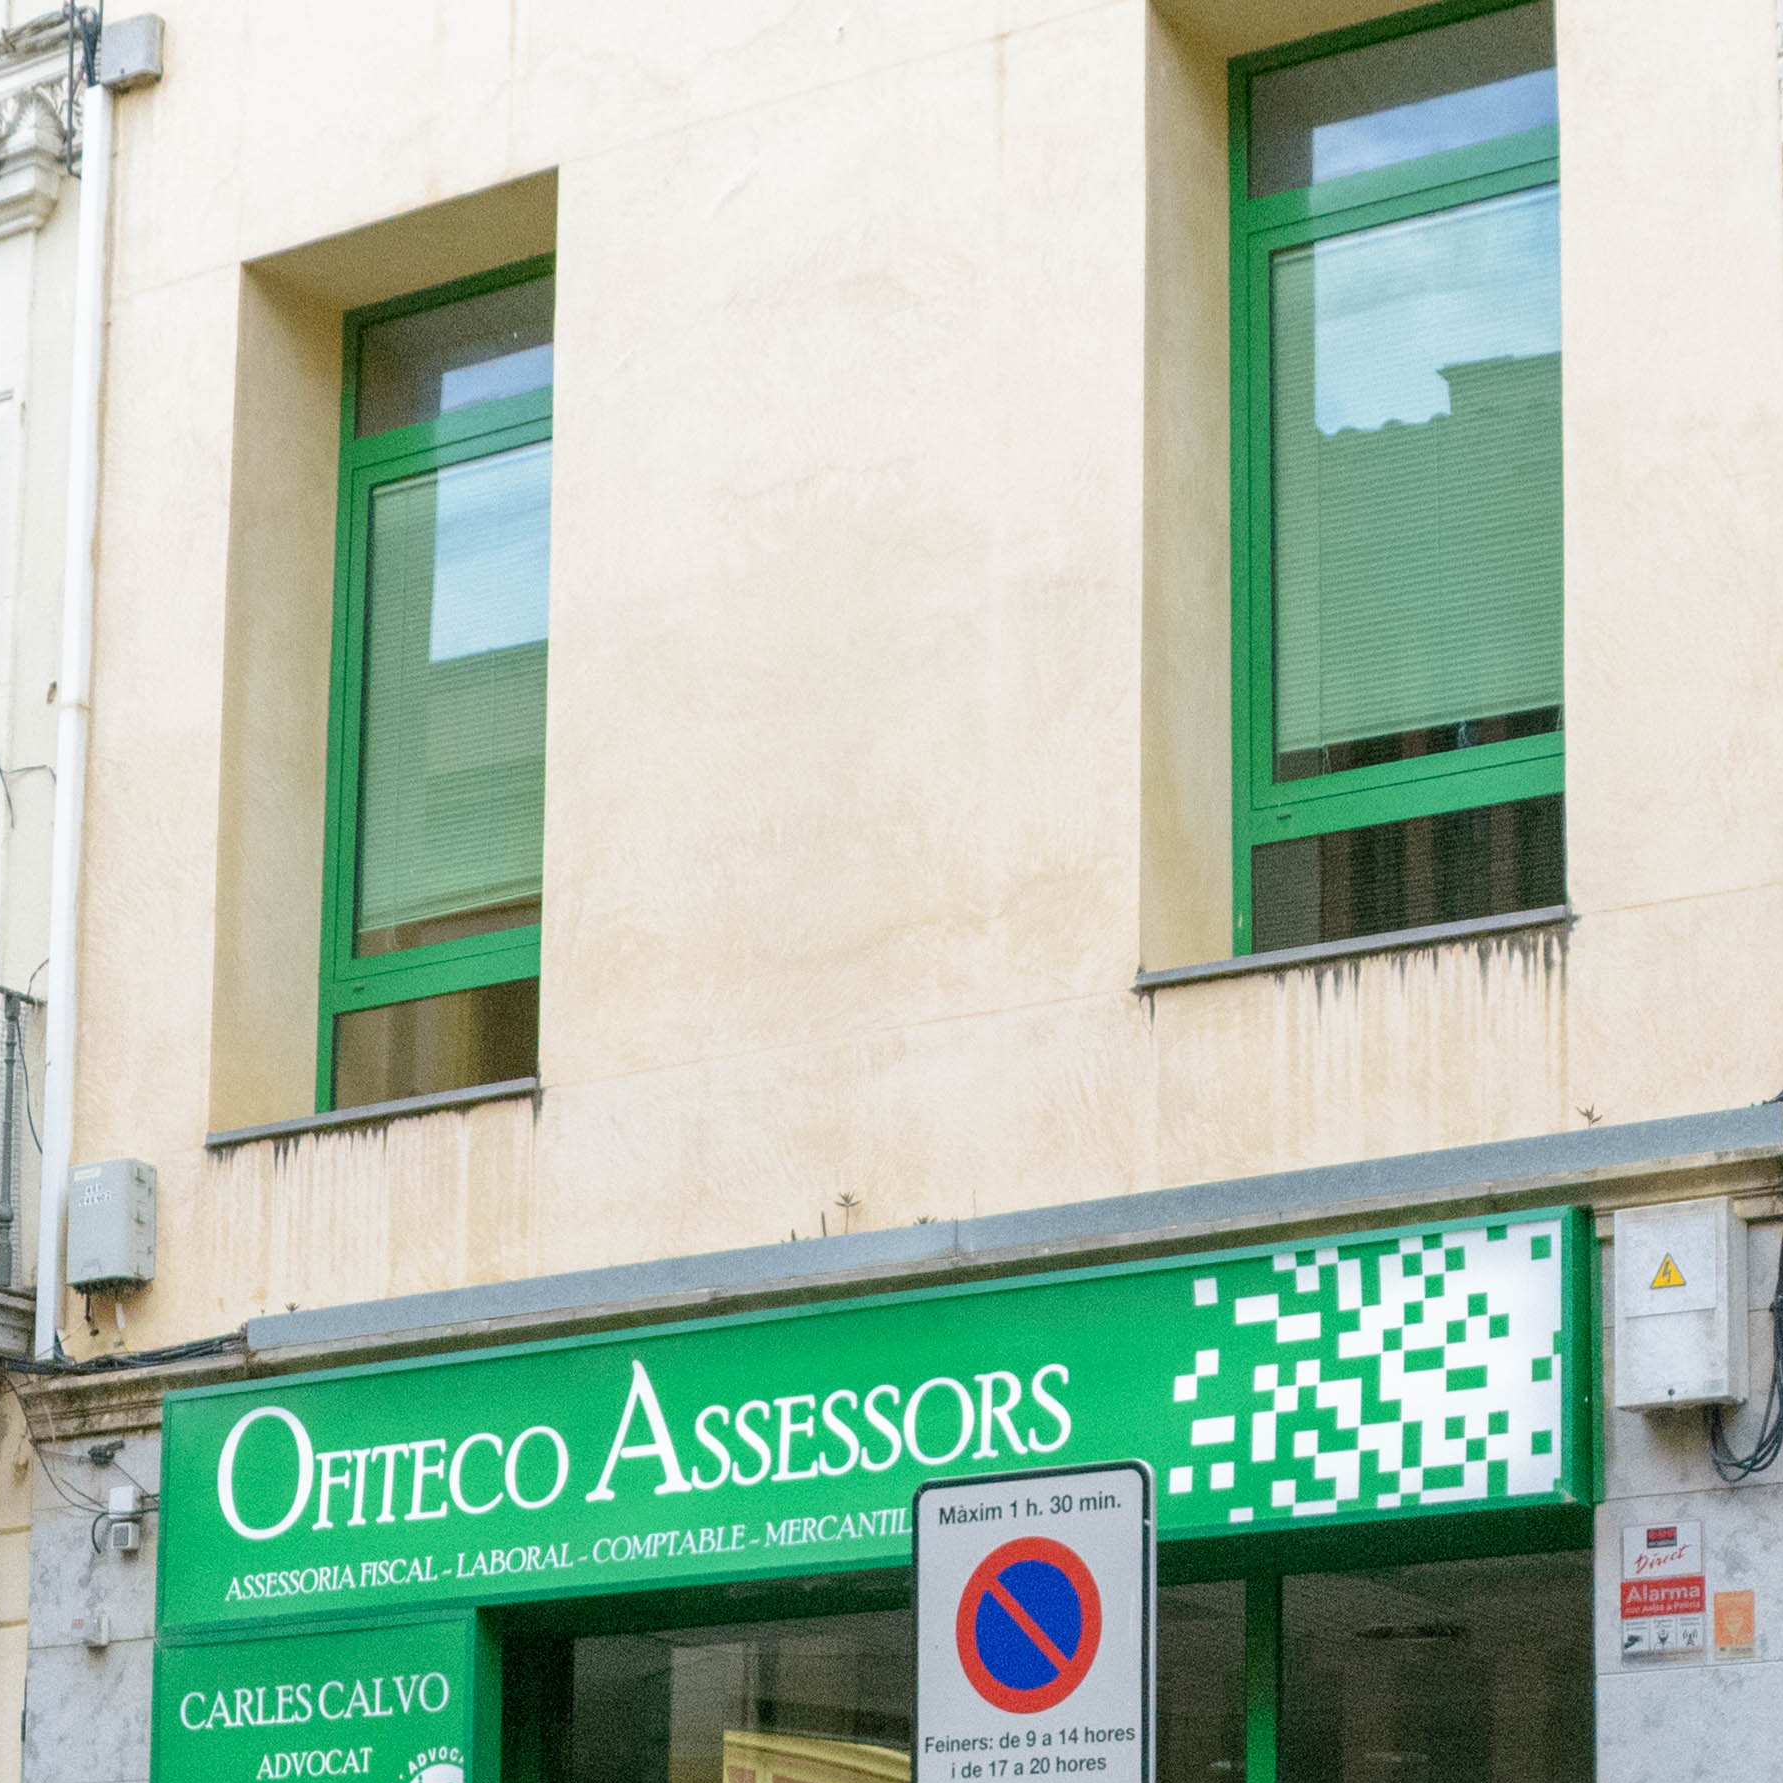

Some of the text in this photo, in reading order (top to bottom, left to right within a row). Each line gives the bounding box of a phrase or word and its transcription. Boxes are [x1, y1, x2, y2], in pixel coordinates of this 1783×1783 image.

[217, 1359, 1073, 1541] OFITECO ASSESSORS
[939, 1491, 1121, 1525] Màxim 1 h. 30 min.
[224, 1563, 354, 1601] ASSESSORIA
[359, 1556, 438, 1588] FISCAL
[456, 1543, 573, 1579] LABORAL
[592, 1523, 745, 1565] COMPTABLE
[764, 1508, 912, 1547] MERCANTIL
[1626, 1584, 1700, 1603] Alarma
[180, 1672, 449, 1730] CARLES CALVO
[925, 1727, 1135, 1753] Feiners: de 9 a 14 hores
[256, 1747, 373, 1780] ADVOCAT
[951, 1756, 1107, 1779] i de 17 a 20 hores
